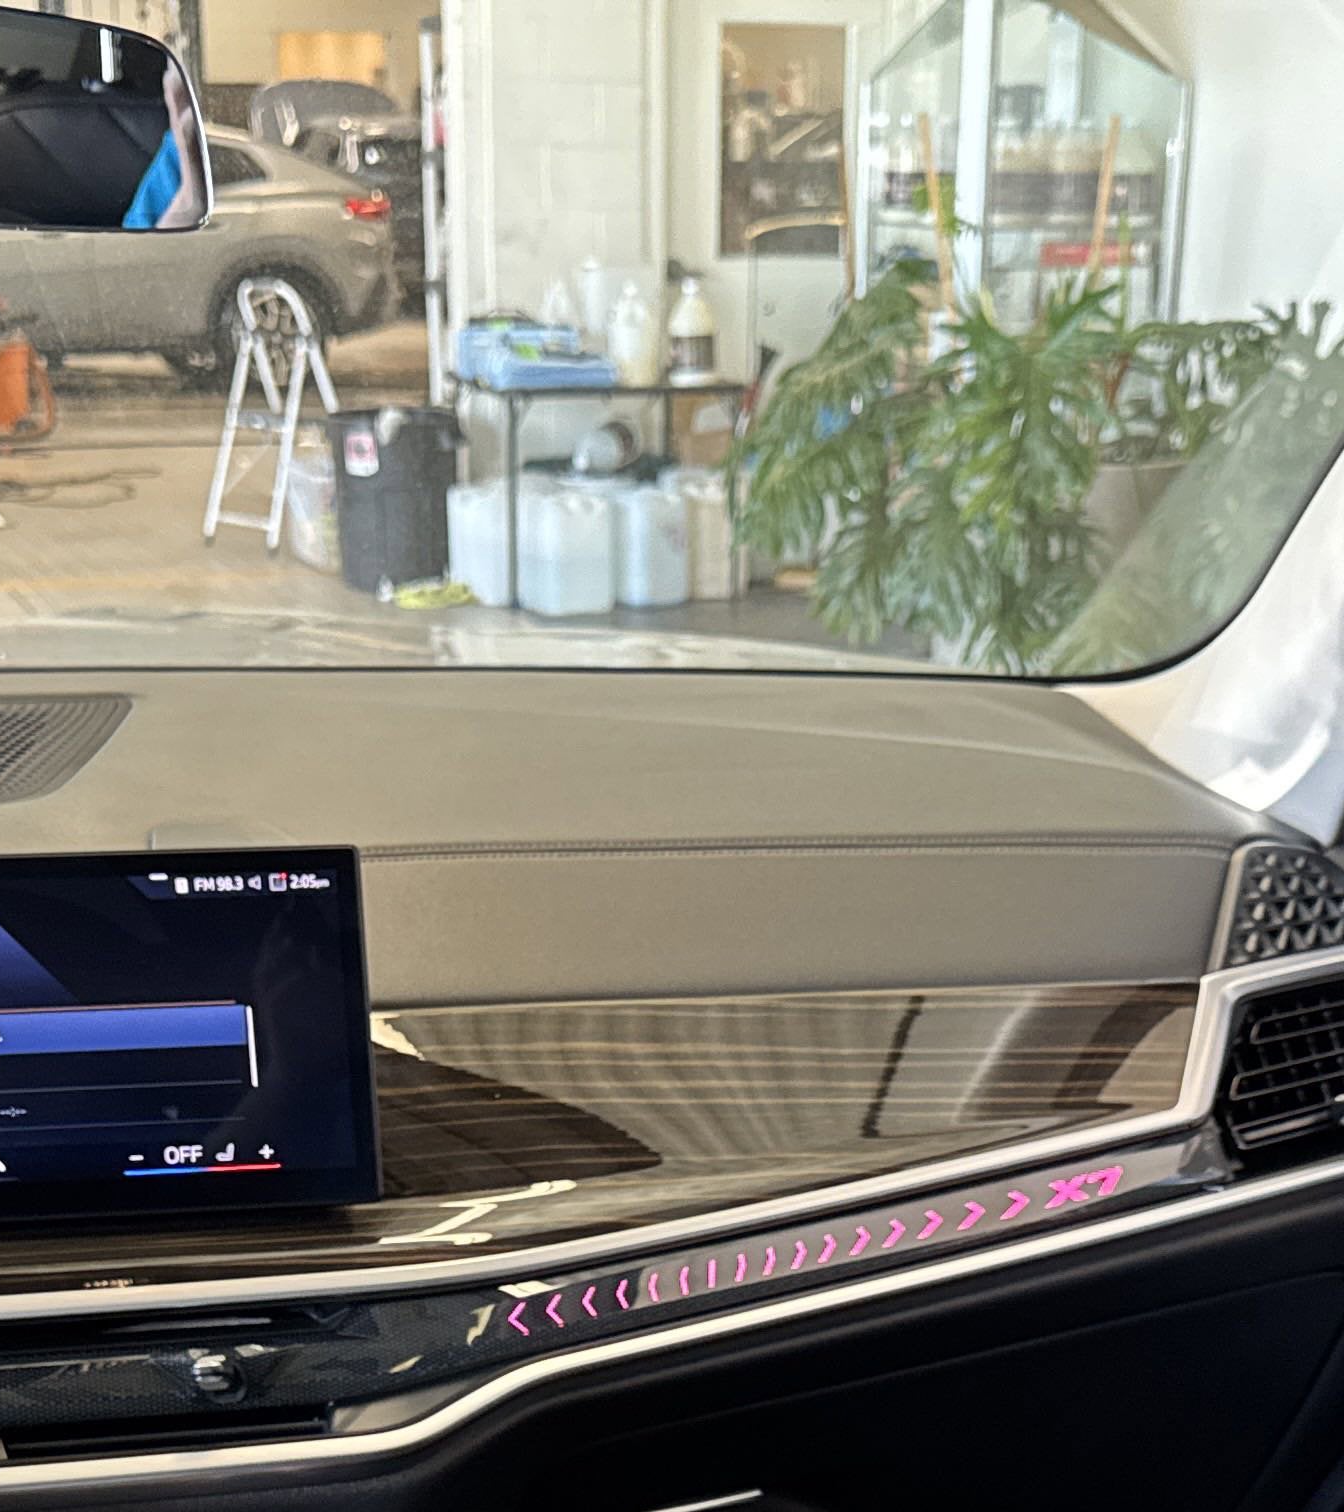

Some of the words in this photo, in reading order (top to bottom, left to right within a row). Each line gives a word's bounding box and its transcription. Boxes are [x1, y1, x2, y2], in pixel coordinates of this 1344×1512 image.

[193, 876, 216, 892] FM
[163, 1144, 204, 1166] OFF
[1043, 1164, 1125, 1211] X7
